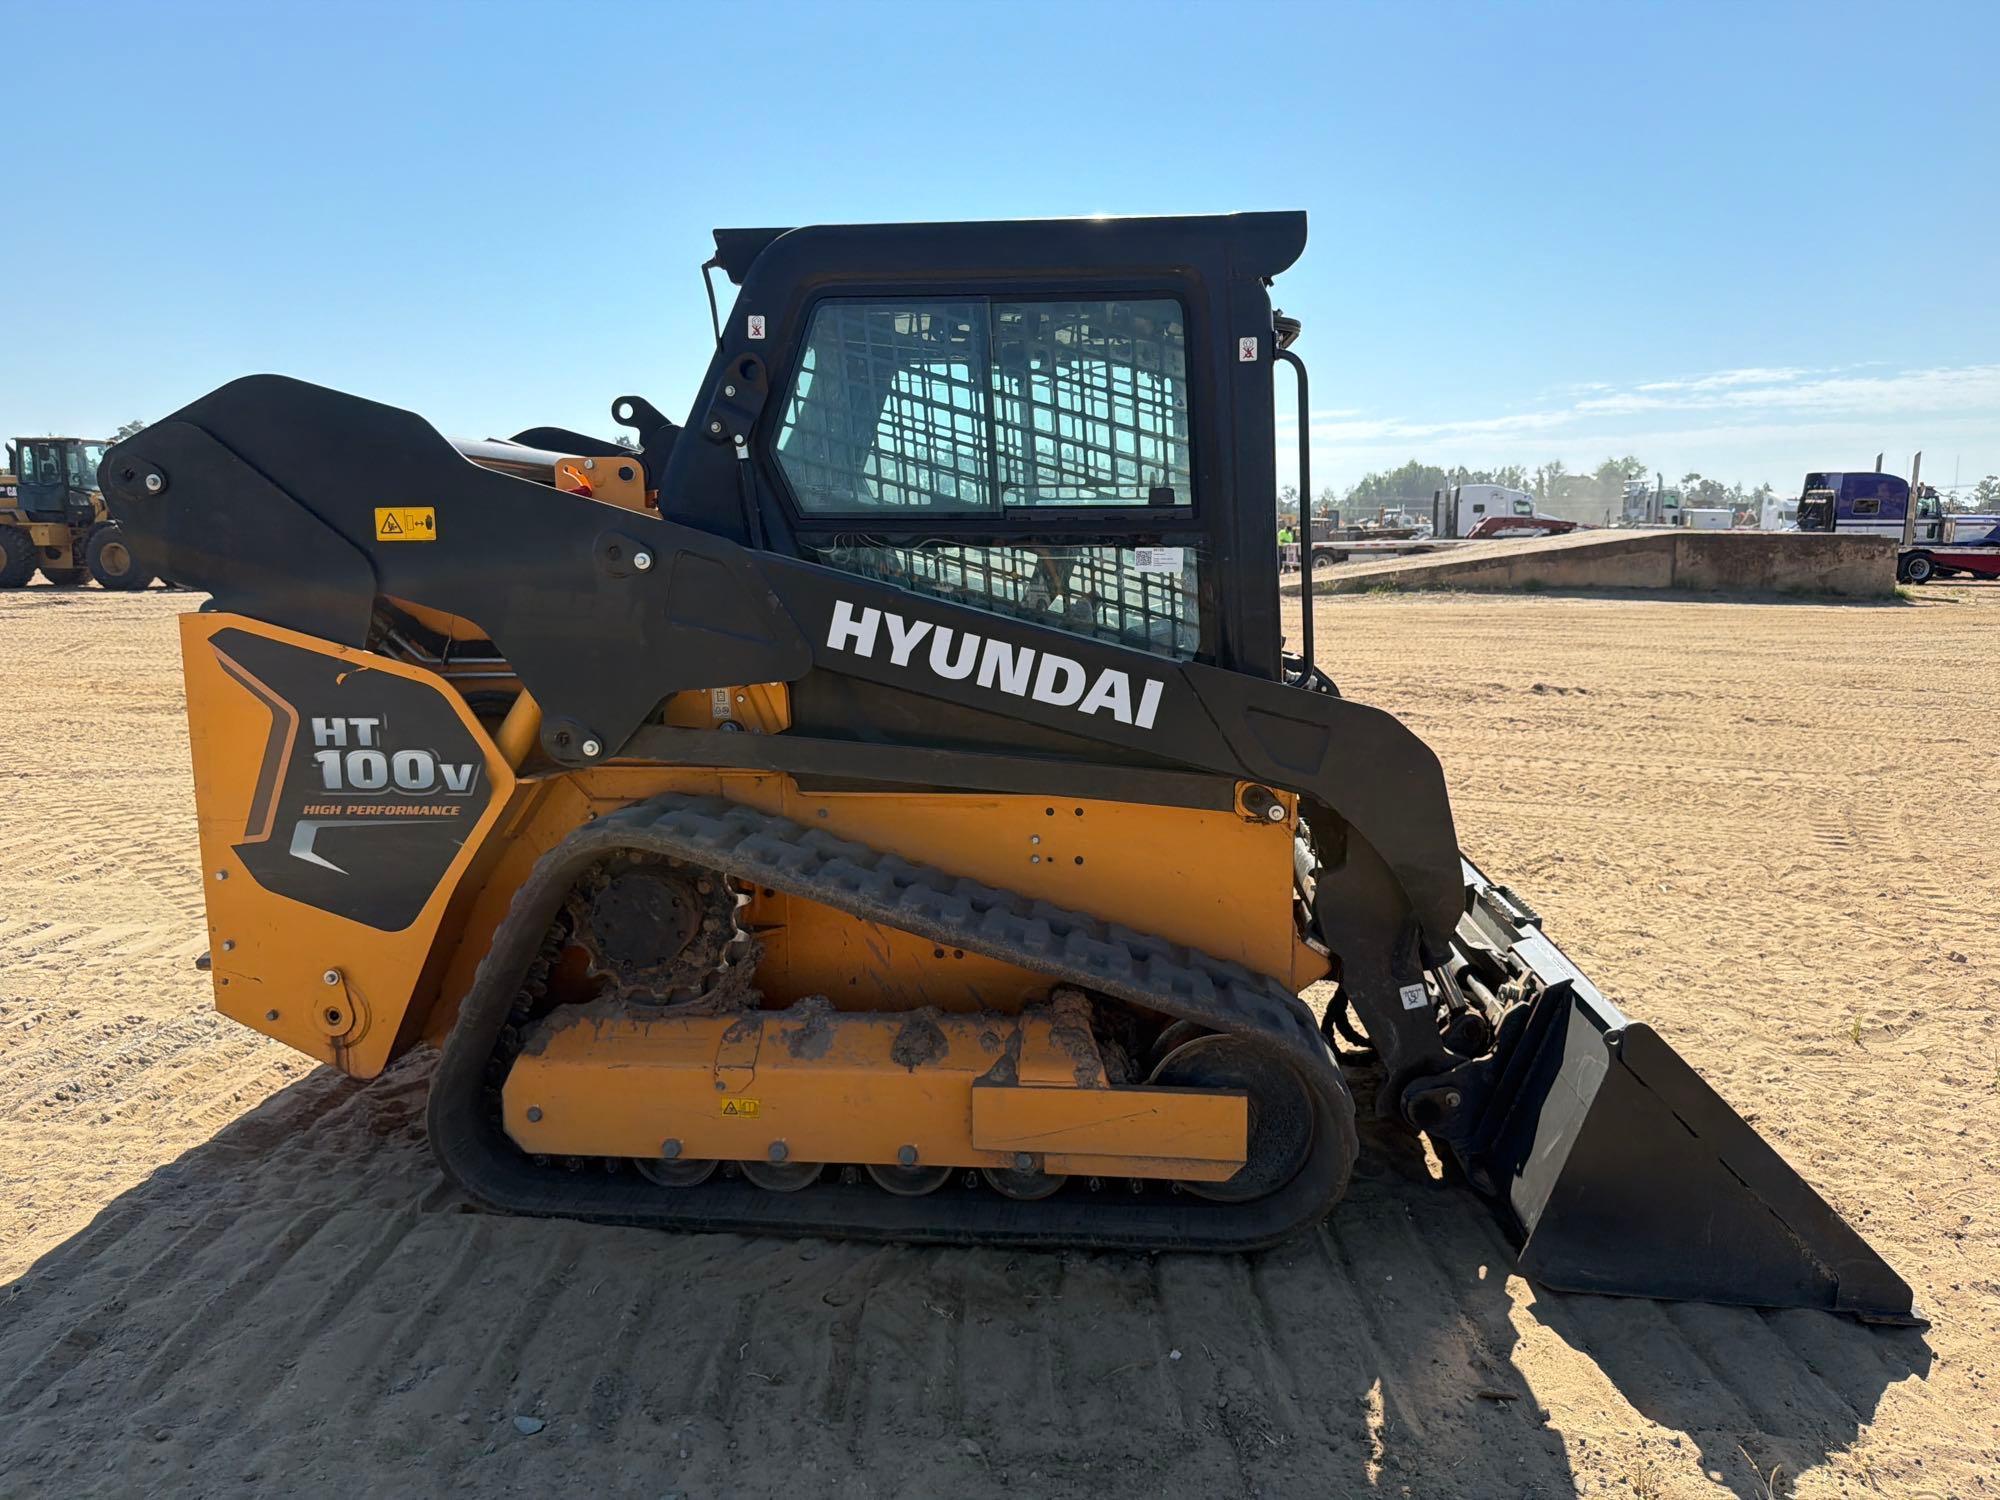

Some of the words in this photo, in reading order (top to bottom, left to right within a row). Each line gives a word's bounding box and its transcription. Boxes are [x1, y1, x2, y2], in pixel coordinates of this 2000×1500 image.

[826, 600, 1165, 730] HYUNDAI
[311, 717, 380, 747] HT
[303, 805, 343, 816] HIGH
[346, 805, 462, 817] PERFORMANCE
